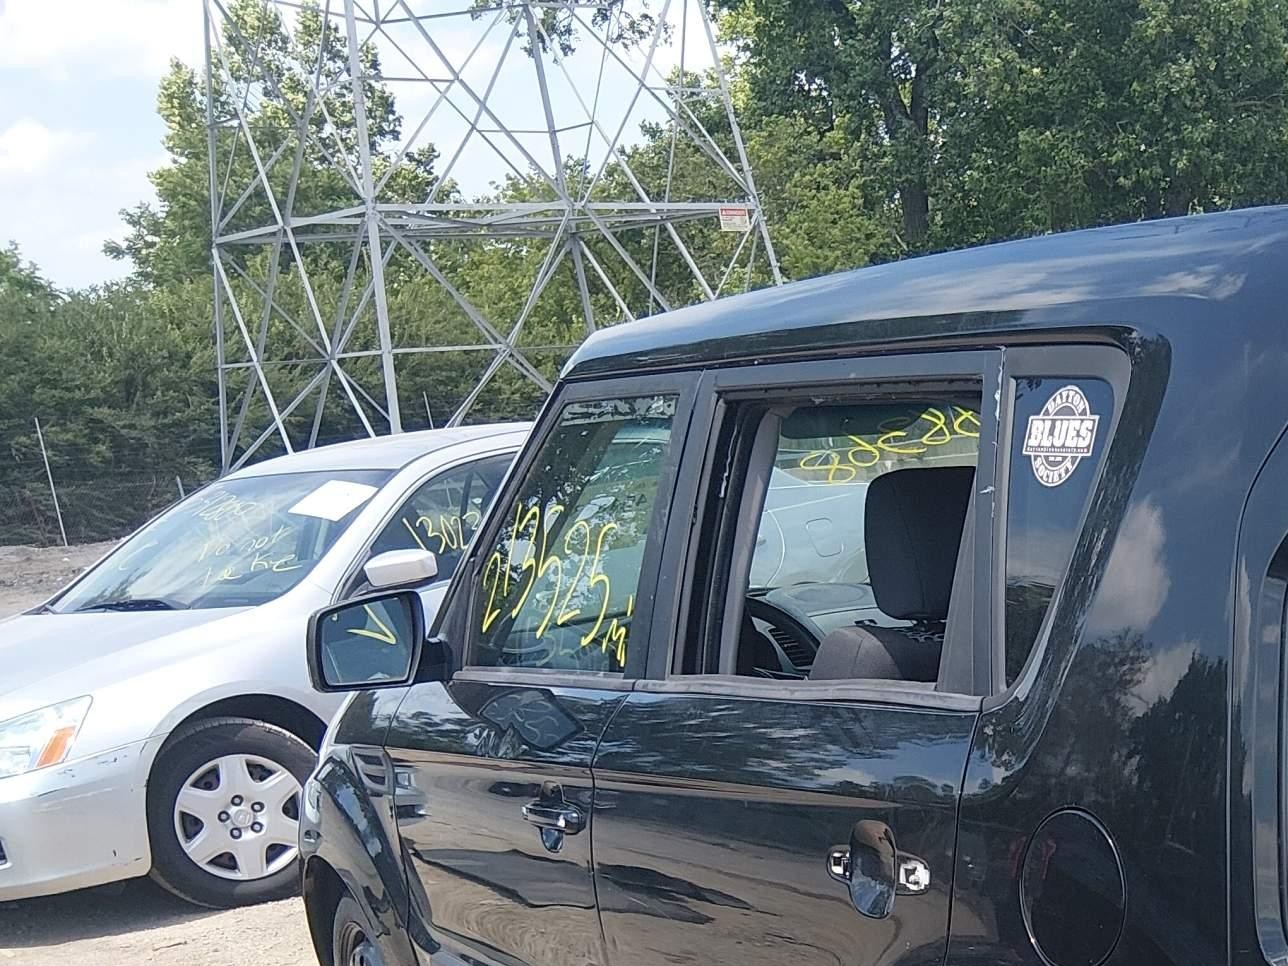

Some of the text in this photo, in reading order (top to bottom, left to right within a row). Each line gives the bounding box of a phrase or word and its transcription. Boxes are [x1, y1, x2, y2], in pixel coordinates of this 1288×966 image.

[1047, 390, 1085, 414] DAYTON
[1027, 420, 1094, 448] BLUES
[1034, 457, 1073, 483] SOCIETY
